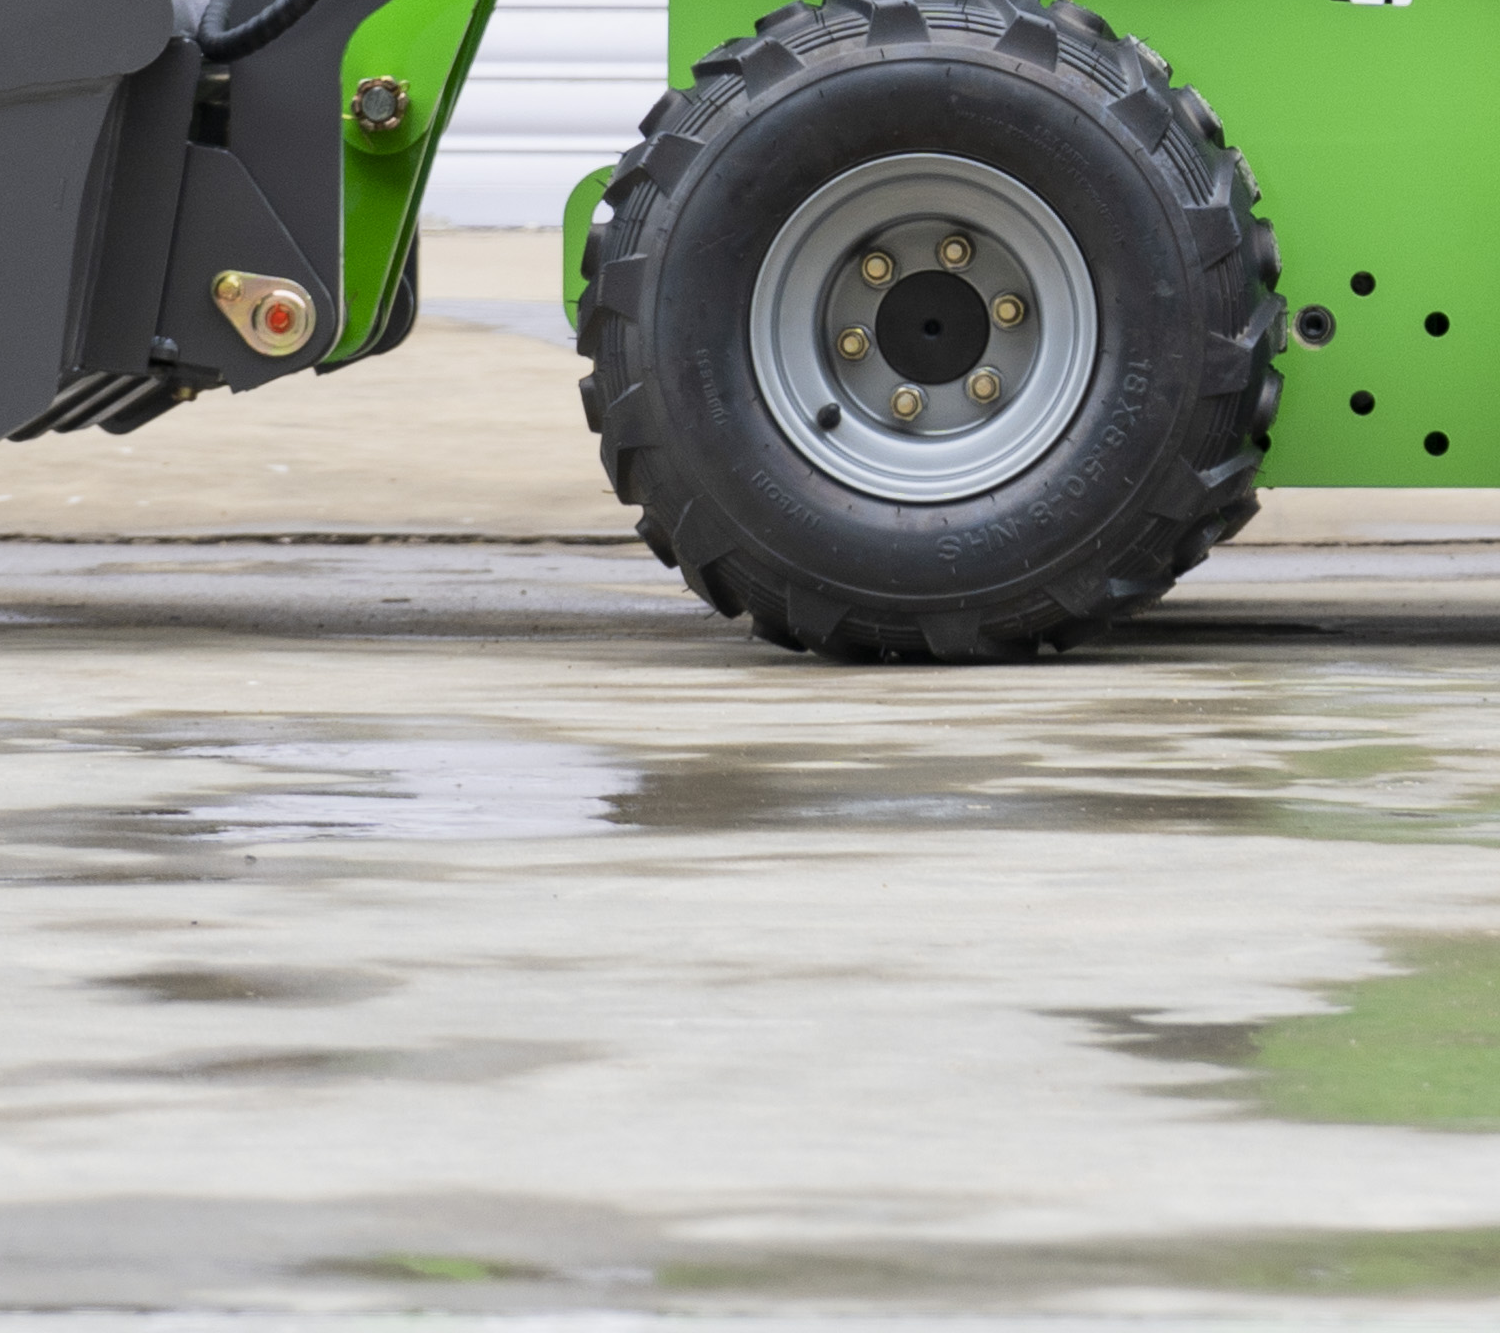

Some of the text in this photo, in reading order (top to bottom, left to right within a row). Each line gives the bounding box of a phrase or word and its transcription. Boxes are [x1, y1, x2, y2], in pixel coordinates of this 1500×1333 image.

[749, 467, 822, 531] NYLON
[934, 354, 1156, 561] 18X8.50-8 NHS
